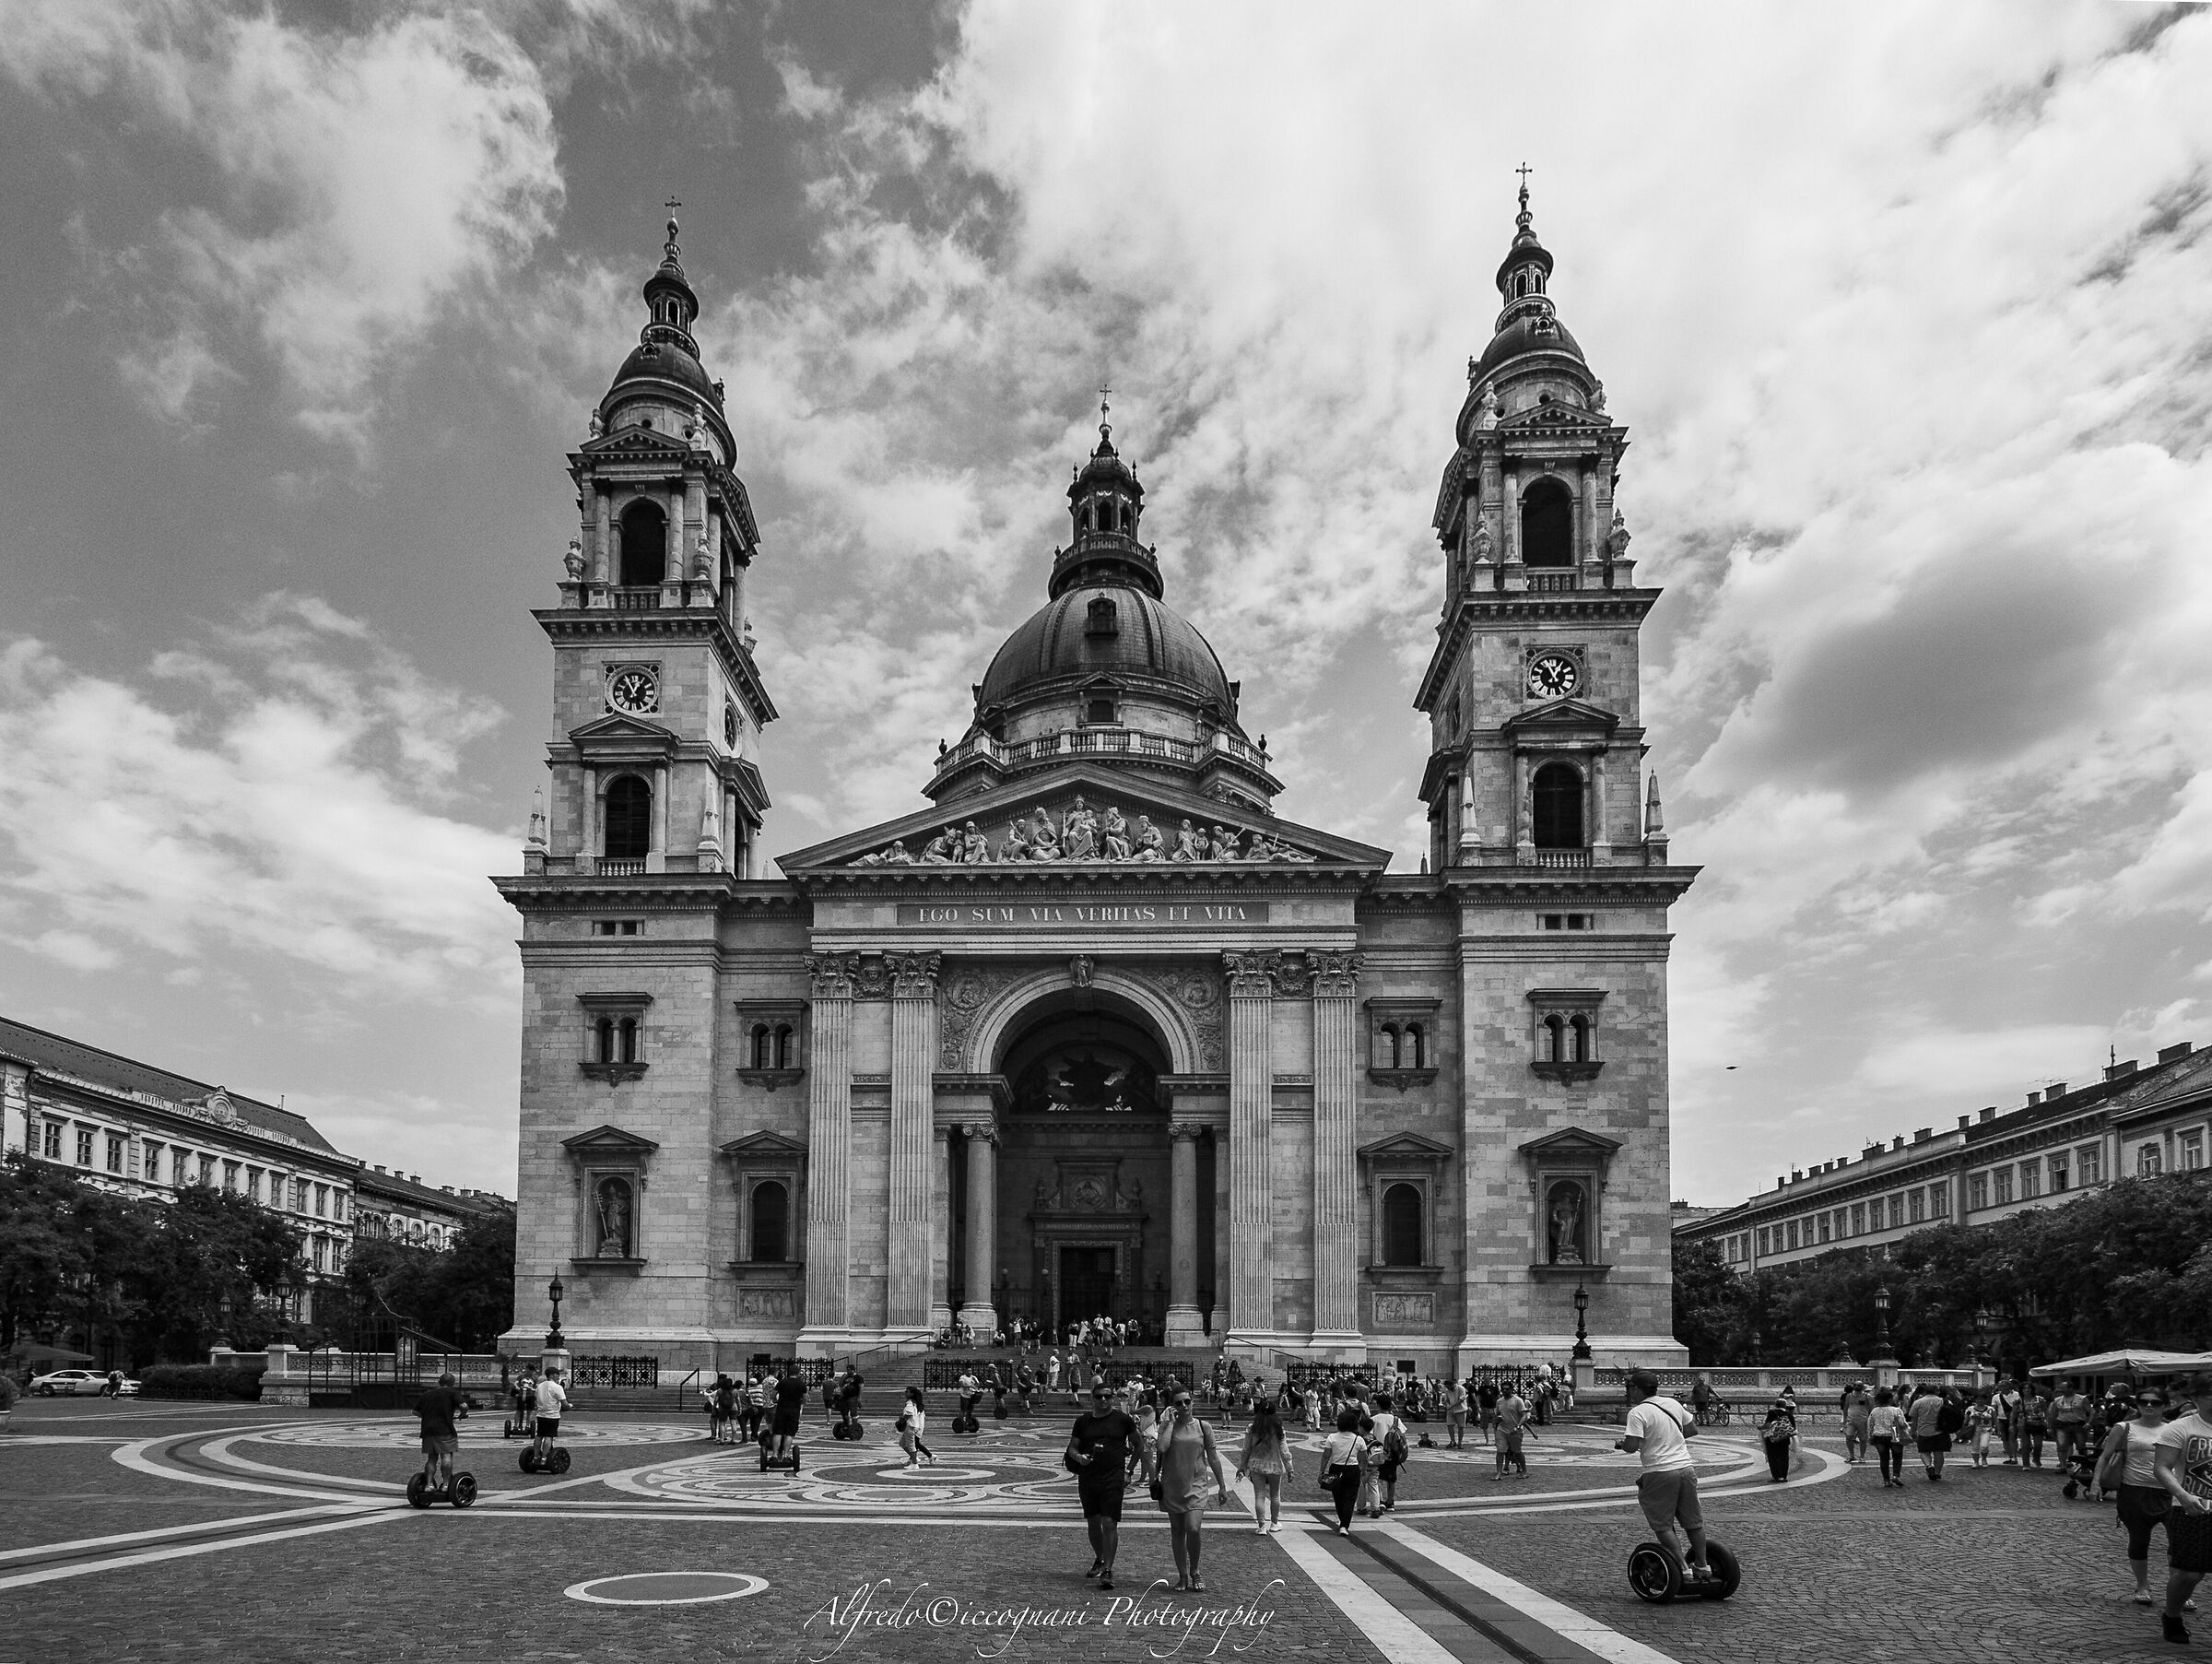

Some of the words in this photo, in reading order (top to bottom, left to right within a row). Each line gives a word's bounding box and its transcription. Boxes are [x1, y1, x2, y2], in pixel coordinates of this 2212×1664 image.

[919, 907, 959, 922] EGO
[971, 907, 1014, 922] SUM
[1030, 907, 1063, 921] VIA
[1076, 906, 1156, 921] VERITAS
[1169, 906, 1192, 920] ET
[1204, 906, 1246, 920] VITA
